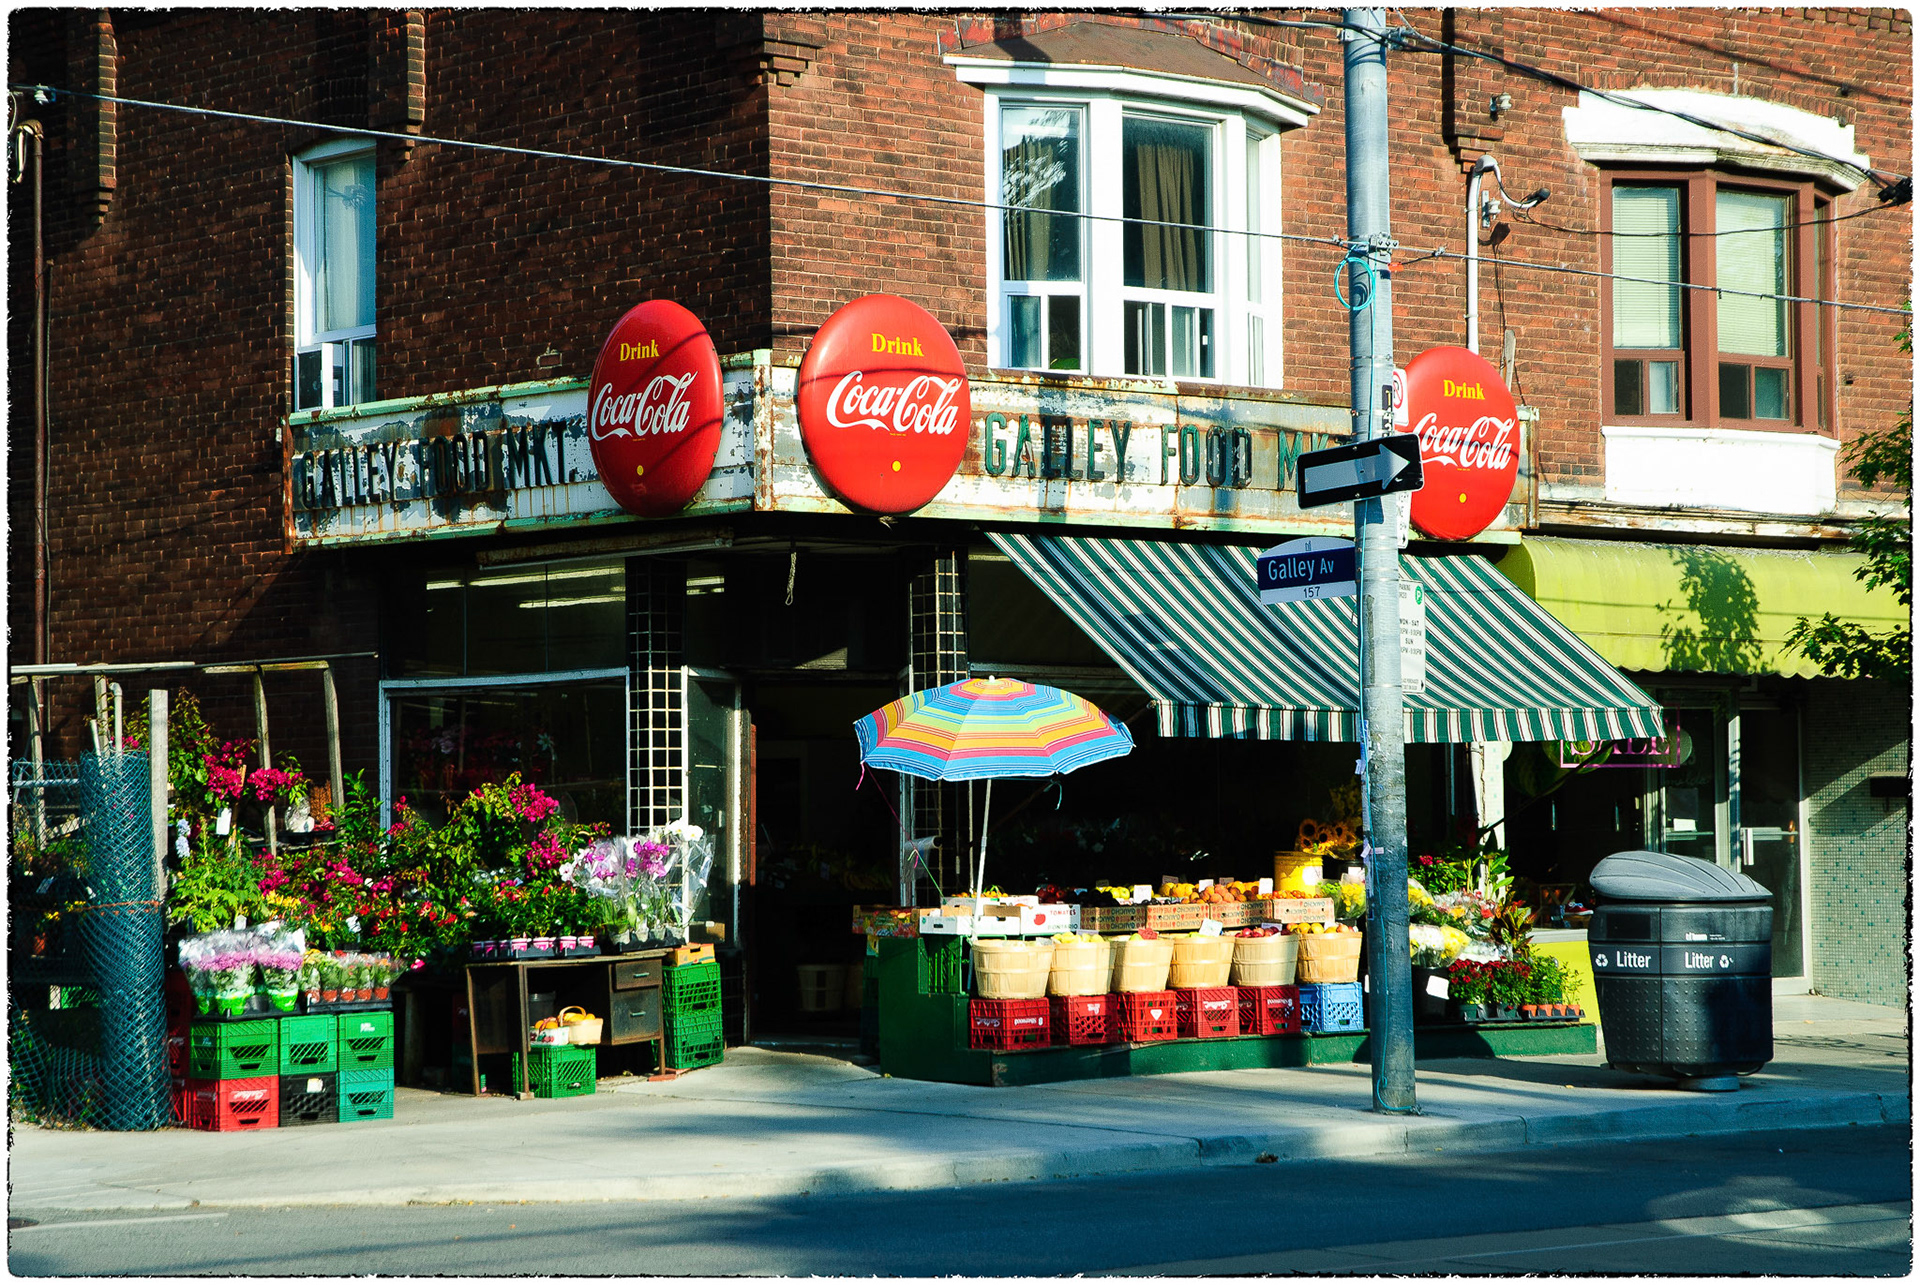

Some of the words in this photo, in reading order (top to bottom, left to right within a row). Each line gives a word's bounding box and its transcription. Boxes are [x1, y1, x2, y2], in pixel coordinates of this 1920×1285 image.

[619, 339, 660, 362] Drink
[871, 333, 925, 357] Drink
[1443, 379, 1486, 401] Drink
[592, 370, 698, 441] Coca-Cola
[826, 370, 963, 436] Coca-Cola
[985, 412, 1132, 484] GALLEY
[1161, 423, 1252, 488] FOOD
[302, 441, 398, 509] GALLEY
[419, 431, 489, 498] FOOD
[1268, 557, 1315, 581] Galley
[1320, 557, 1334, 574] Av
[1303, 586, 1320, 598] 157
[1616, 951, 1651, 968] Litter
[1685, 951, 1714, 969] Litter
